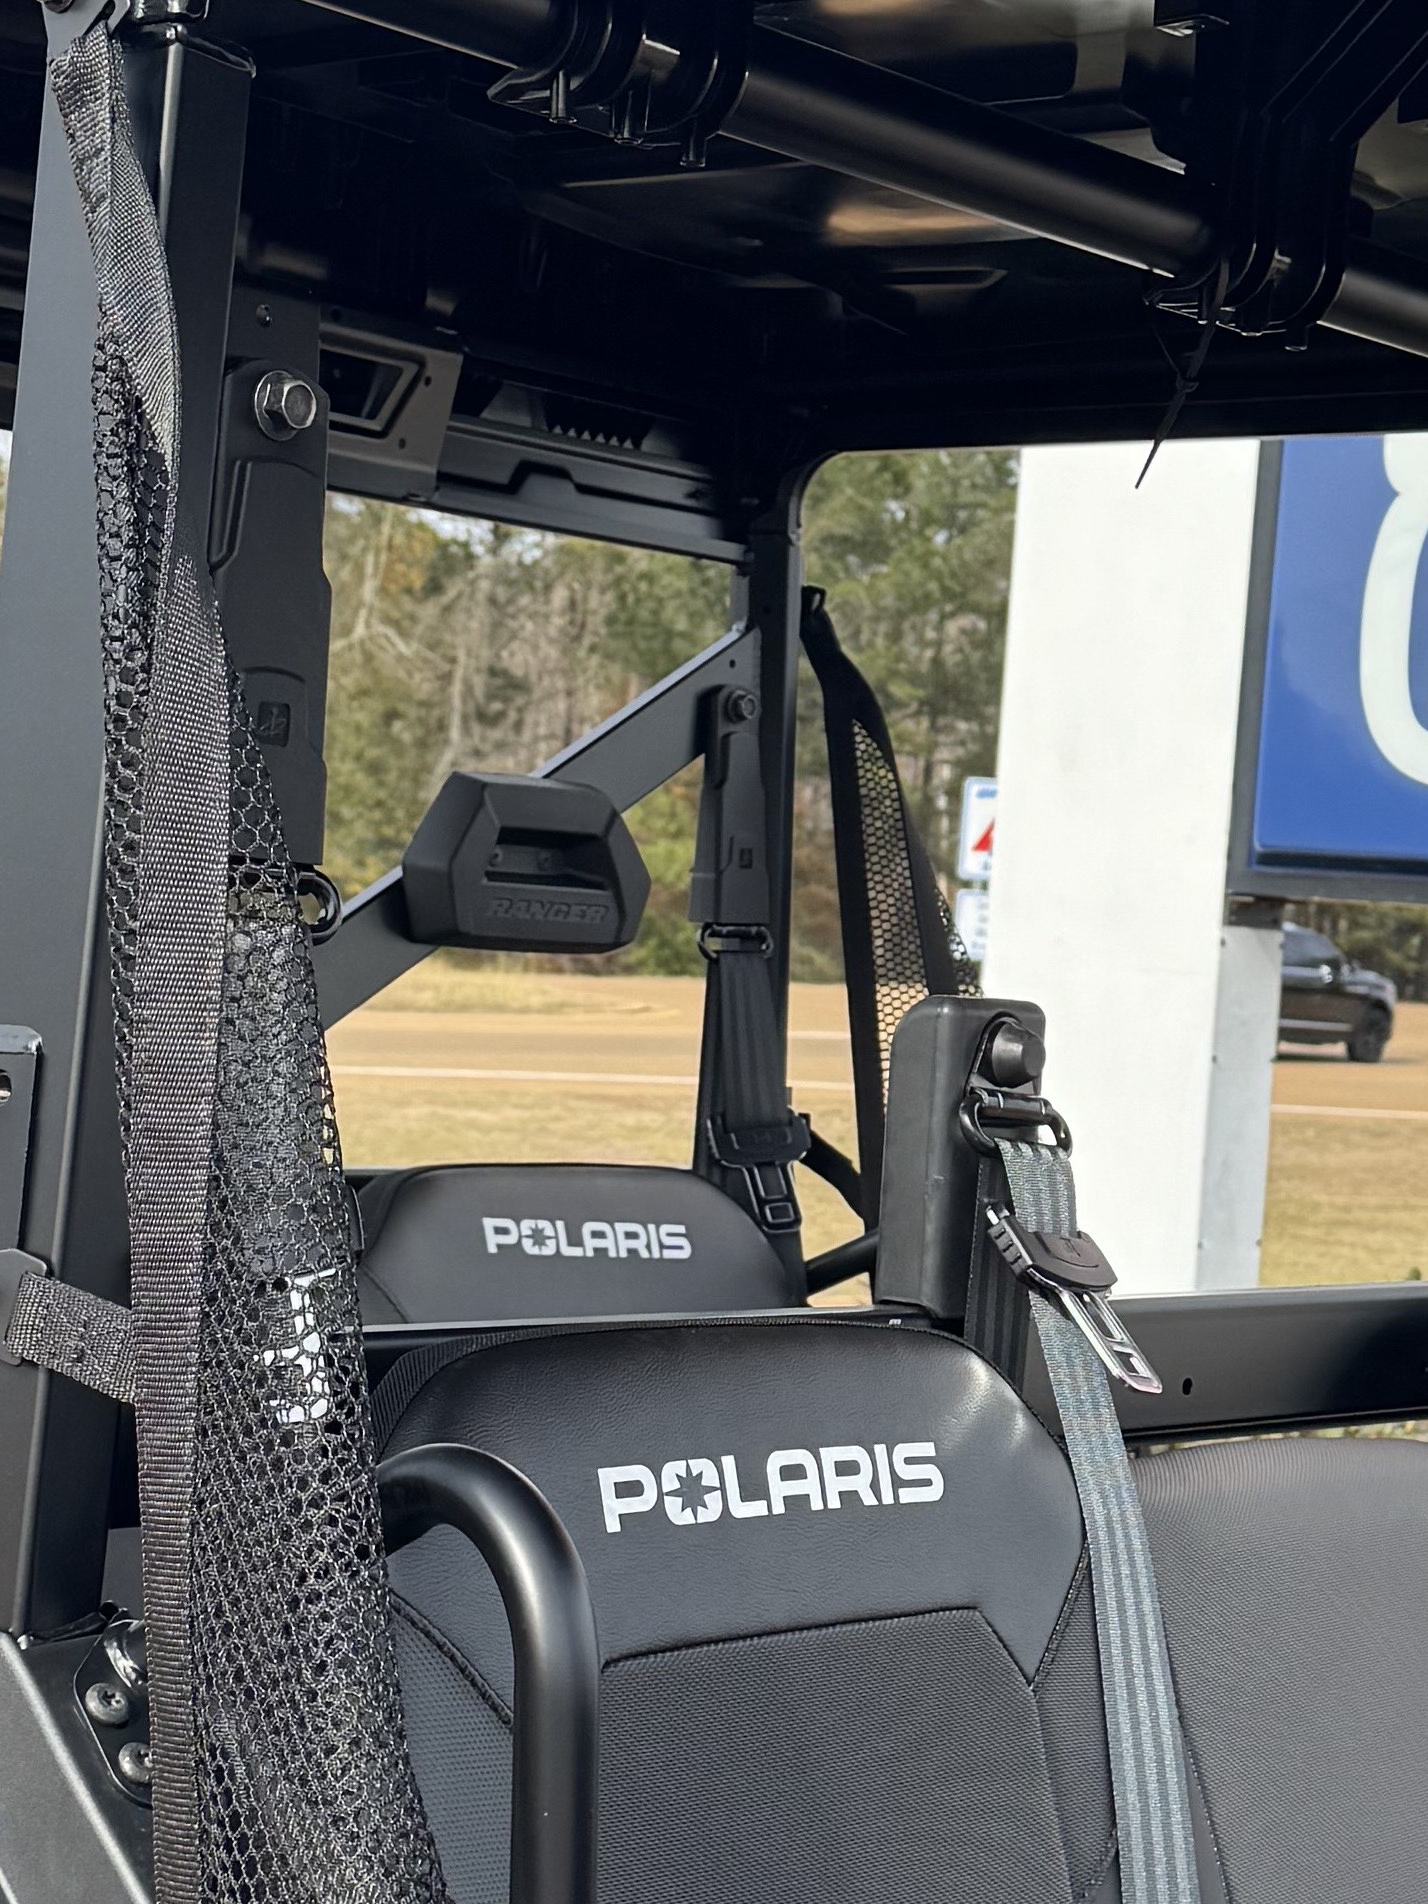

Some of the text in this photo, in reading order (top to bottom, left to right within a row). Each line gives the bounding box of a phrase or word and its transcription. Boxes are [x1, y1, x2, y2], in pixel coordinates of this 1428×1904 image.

[489, 897, 609, 924] RANGER
[481, 1216, 692, 1260] POLARIS
[597, 1441, 945, 1534] POLARIS
